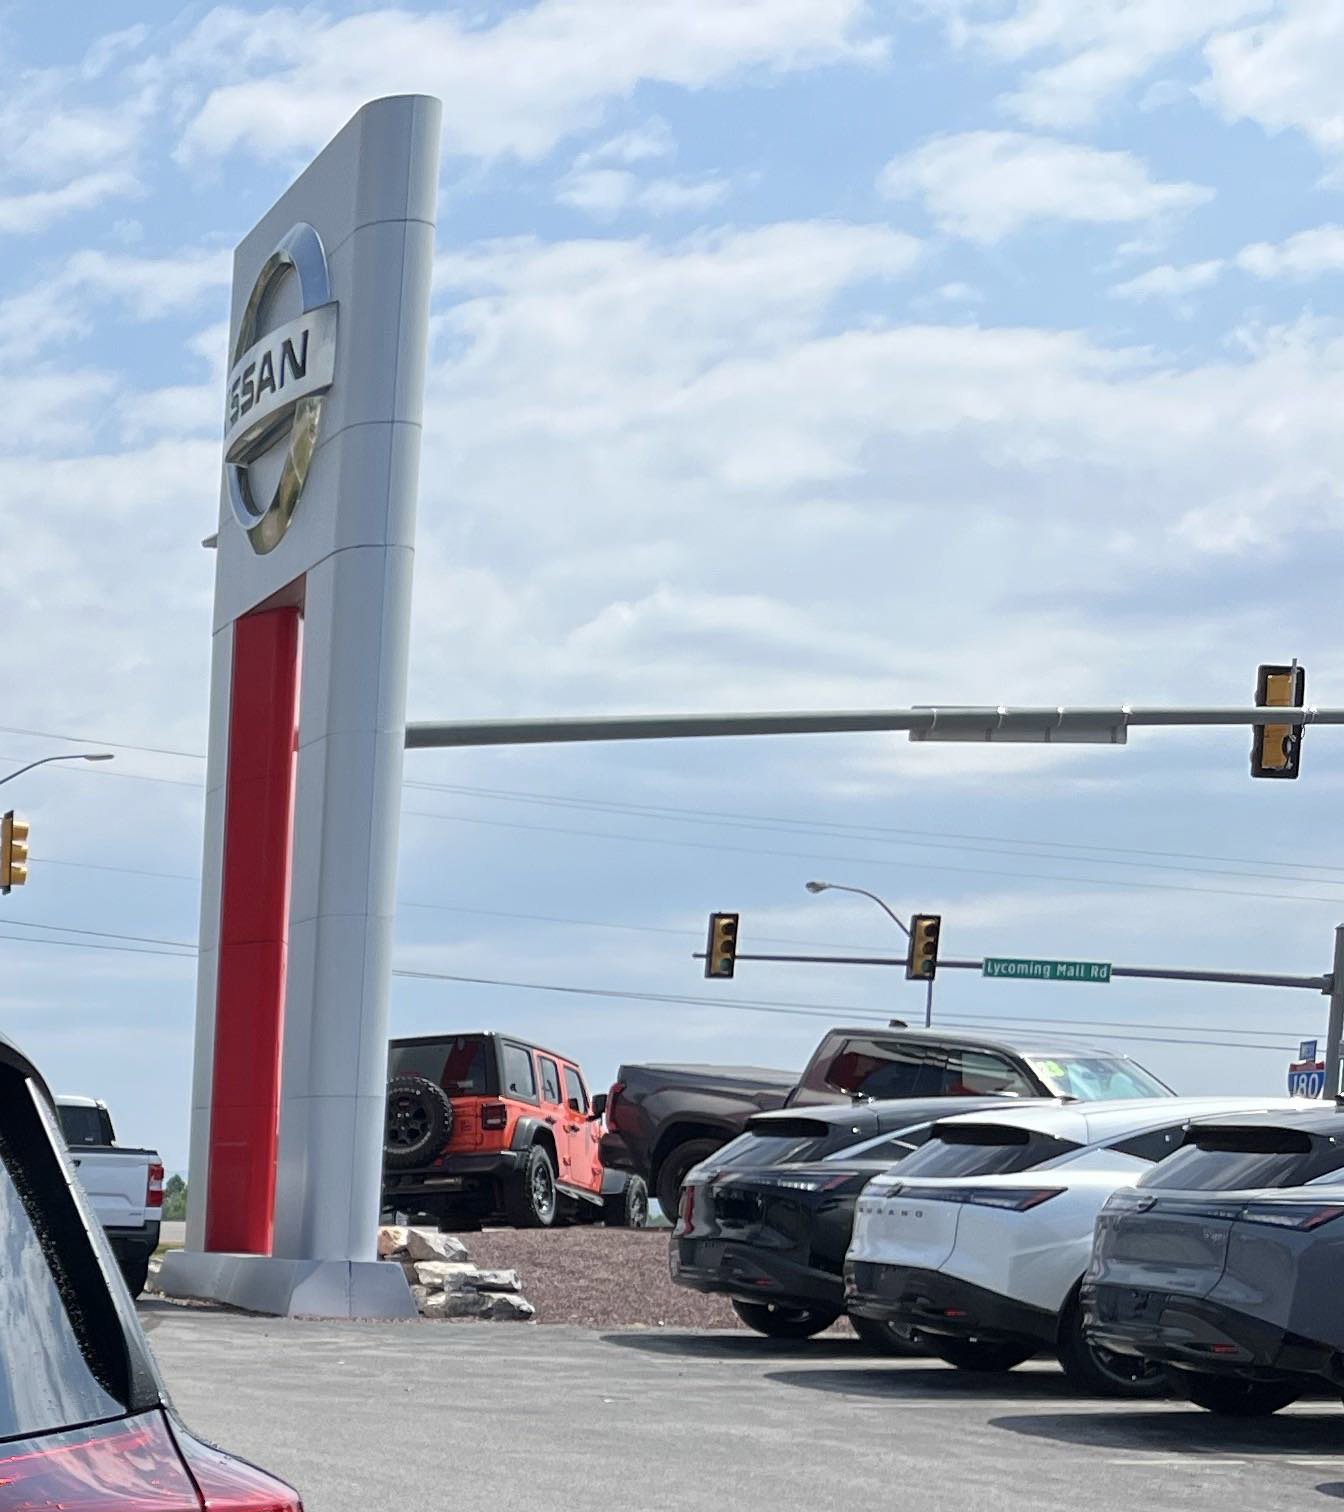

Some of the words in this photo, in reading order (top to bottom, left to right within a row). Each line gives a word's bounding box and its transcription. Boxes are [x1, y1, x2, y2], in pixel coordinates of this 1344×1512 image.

[226, 329, 309, 428] SSAN
[987, 961, 1051, 979] Lycoming
[1056, 963, 1085, 978] Mall
[1090, 965, 1108, 979] Rd
[1292, 1073, 1319, 1098] 180
